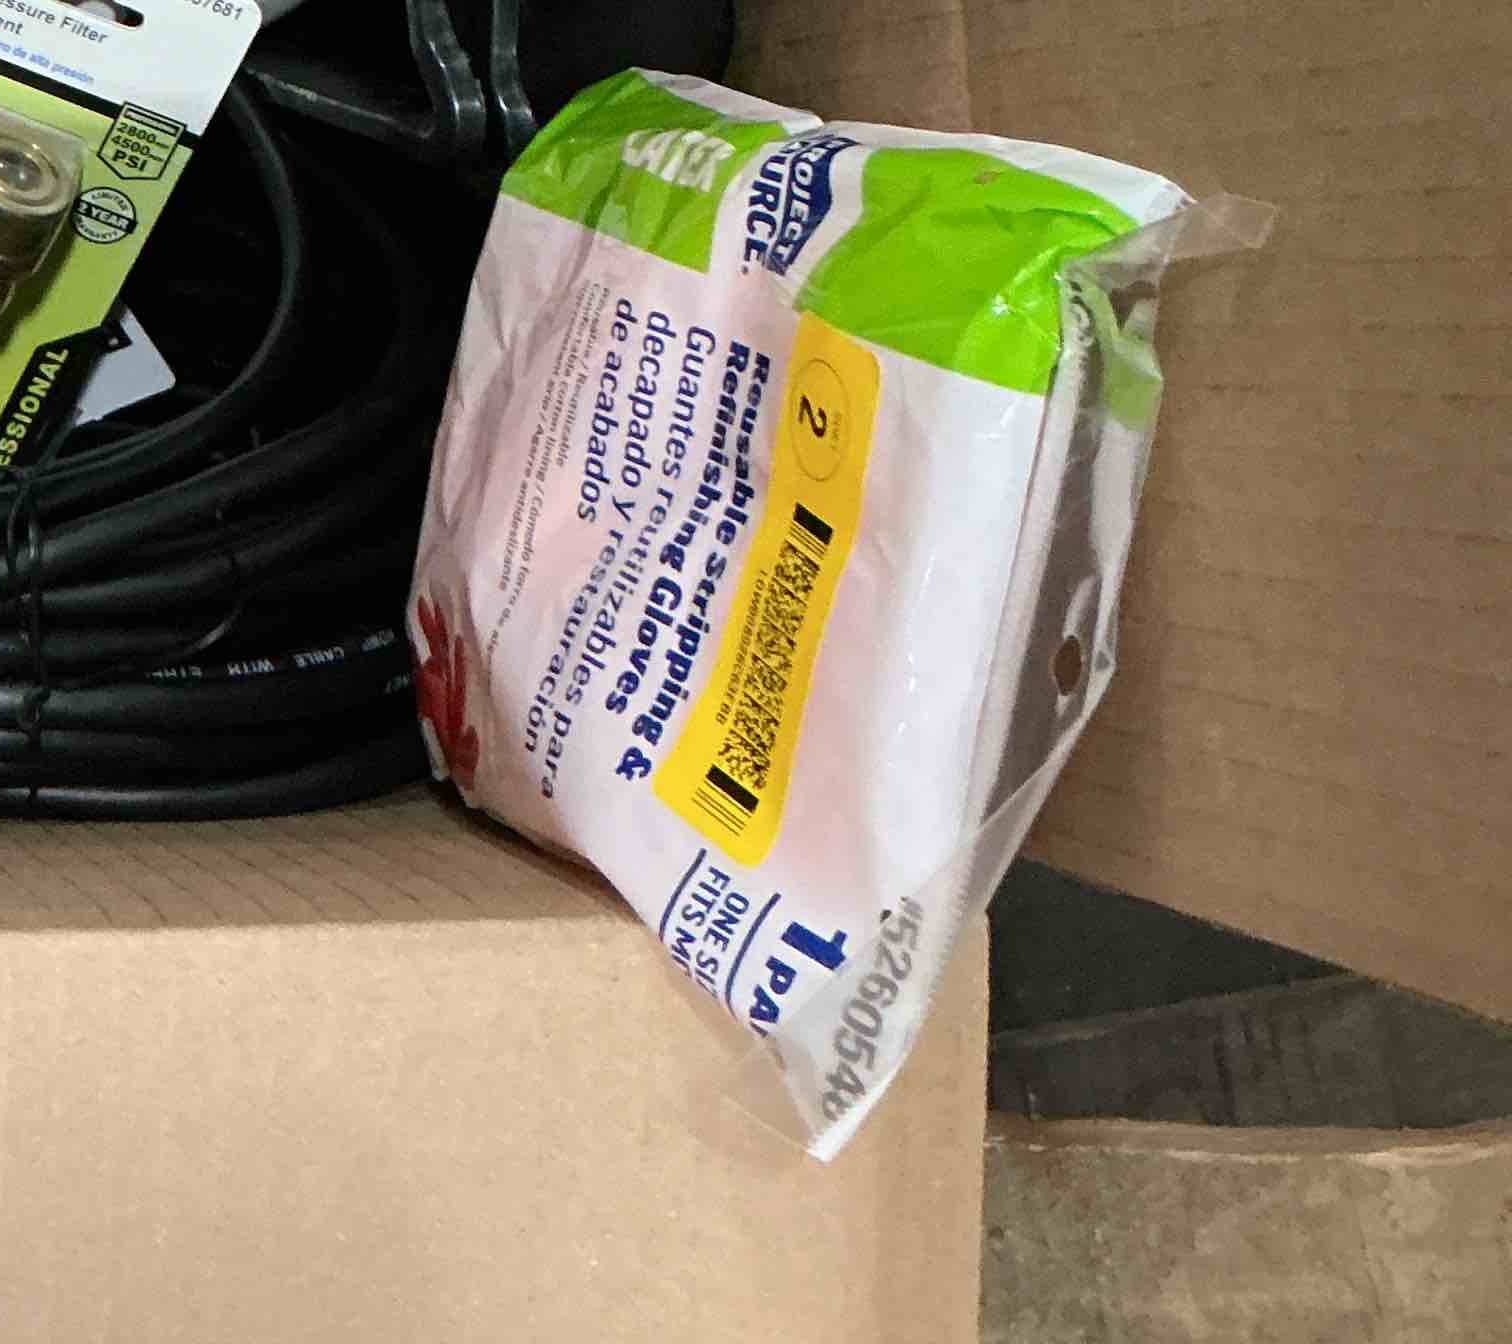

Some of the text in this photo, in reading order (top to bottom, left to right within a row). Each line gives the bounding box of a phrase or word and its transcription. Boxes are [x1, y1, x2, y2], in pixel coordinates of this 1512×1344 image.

[60, 15, 110, 44] Filter
[110, 135, 151, 156] 4500
[112, 149, 149, 172] PSI
[116, 122, 157, 143] 2800
[772, 136, 833, 263] ROJECT
[576, 297, 638, 525] de acabados
[798, 393, 828, 439] 2
[658, 340, 751, 573] Refinishing
[714, 351, 771, 547] Reusable
[524, 310, 678, 754] decapado y restauración
[541, 325, 717, 800] Guantes reutilizables para
[604, 576, 683, 715] Gloves
[631, 551, 728, 747] Stripping
[615, 745, 652, 782] &
[681, 865, 732, 928] FITS
[703, 891, 751, 953] ONE
[780, 920, 848, 972] 1
